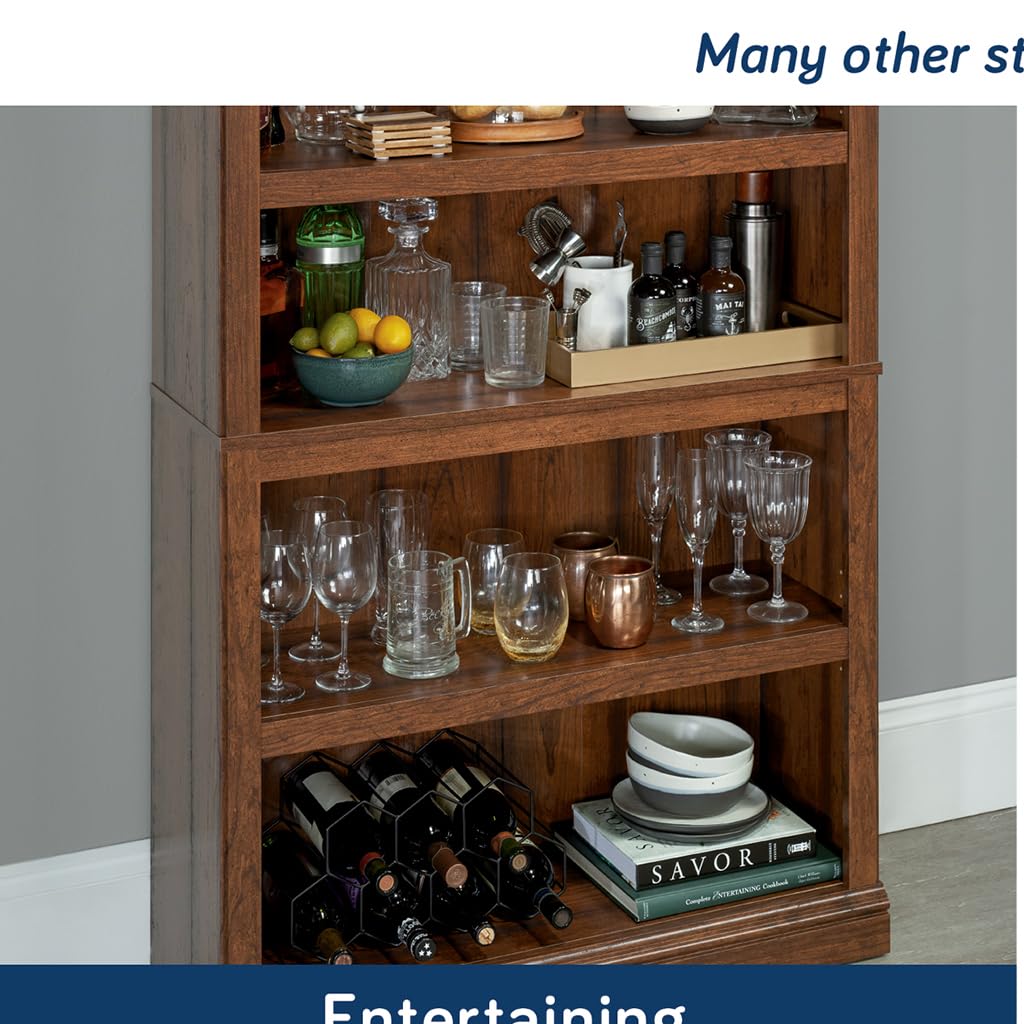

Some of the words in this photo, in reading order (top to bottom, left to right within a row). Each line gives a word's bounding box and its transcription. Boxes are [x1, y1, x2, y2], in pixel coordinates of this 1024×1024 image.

[715, 303, 732, 311] MAI
[651, 848, 754, 885] SAVOR
[685, 895, 711, 906] Complete
[711, 884, 762, 900] ENTERTAINING
[762, 878, 789, 890] Cookbook
